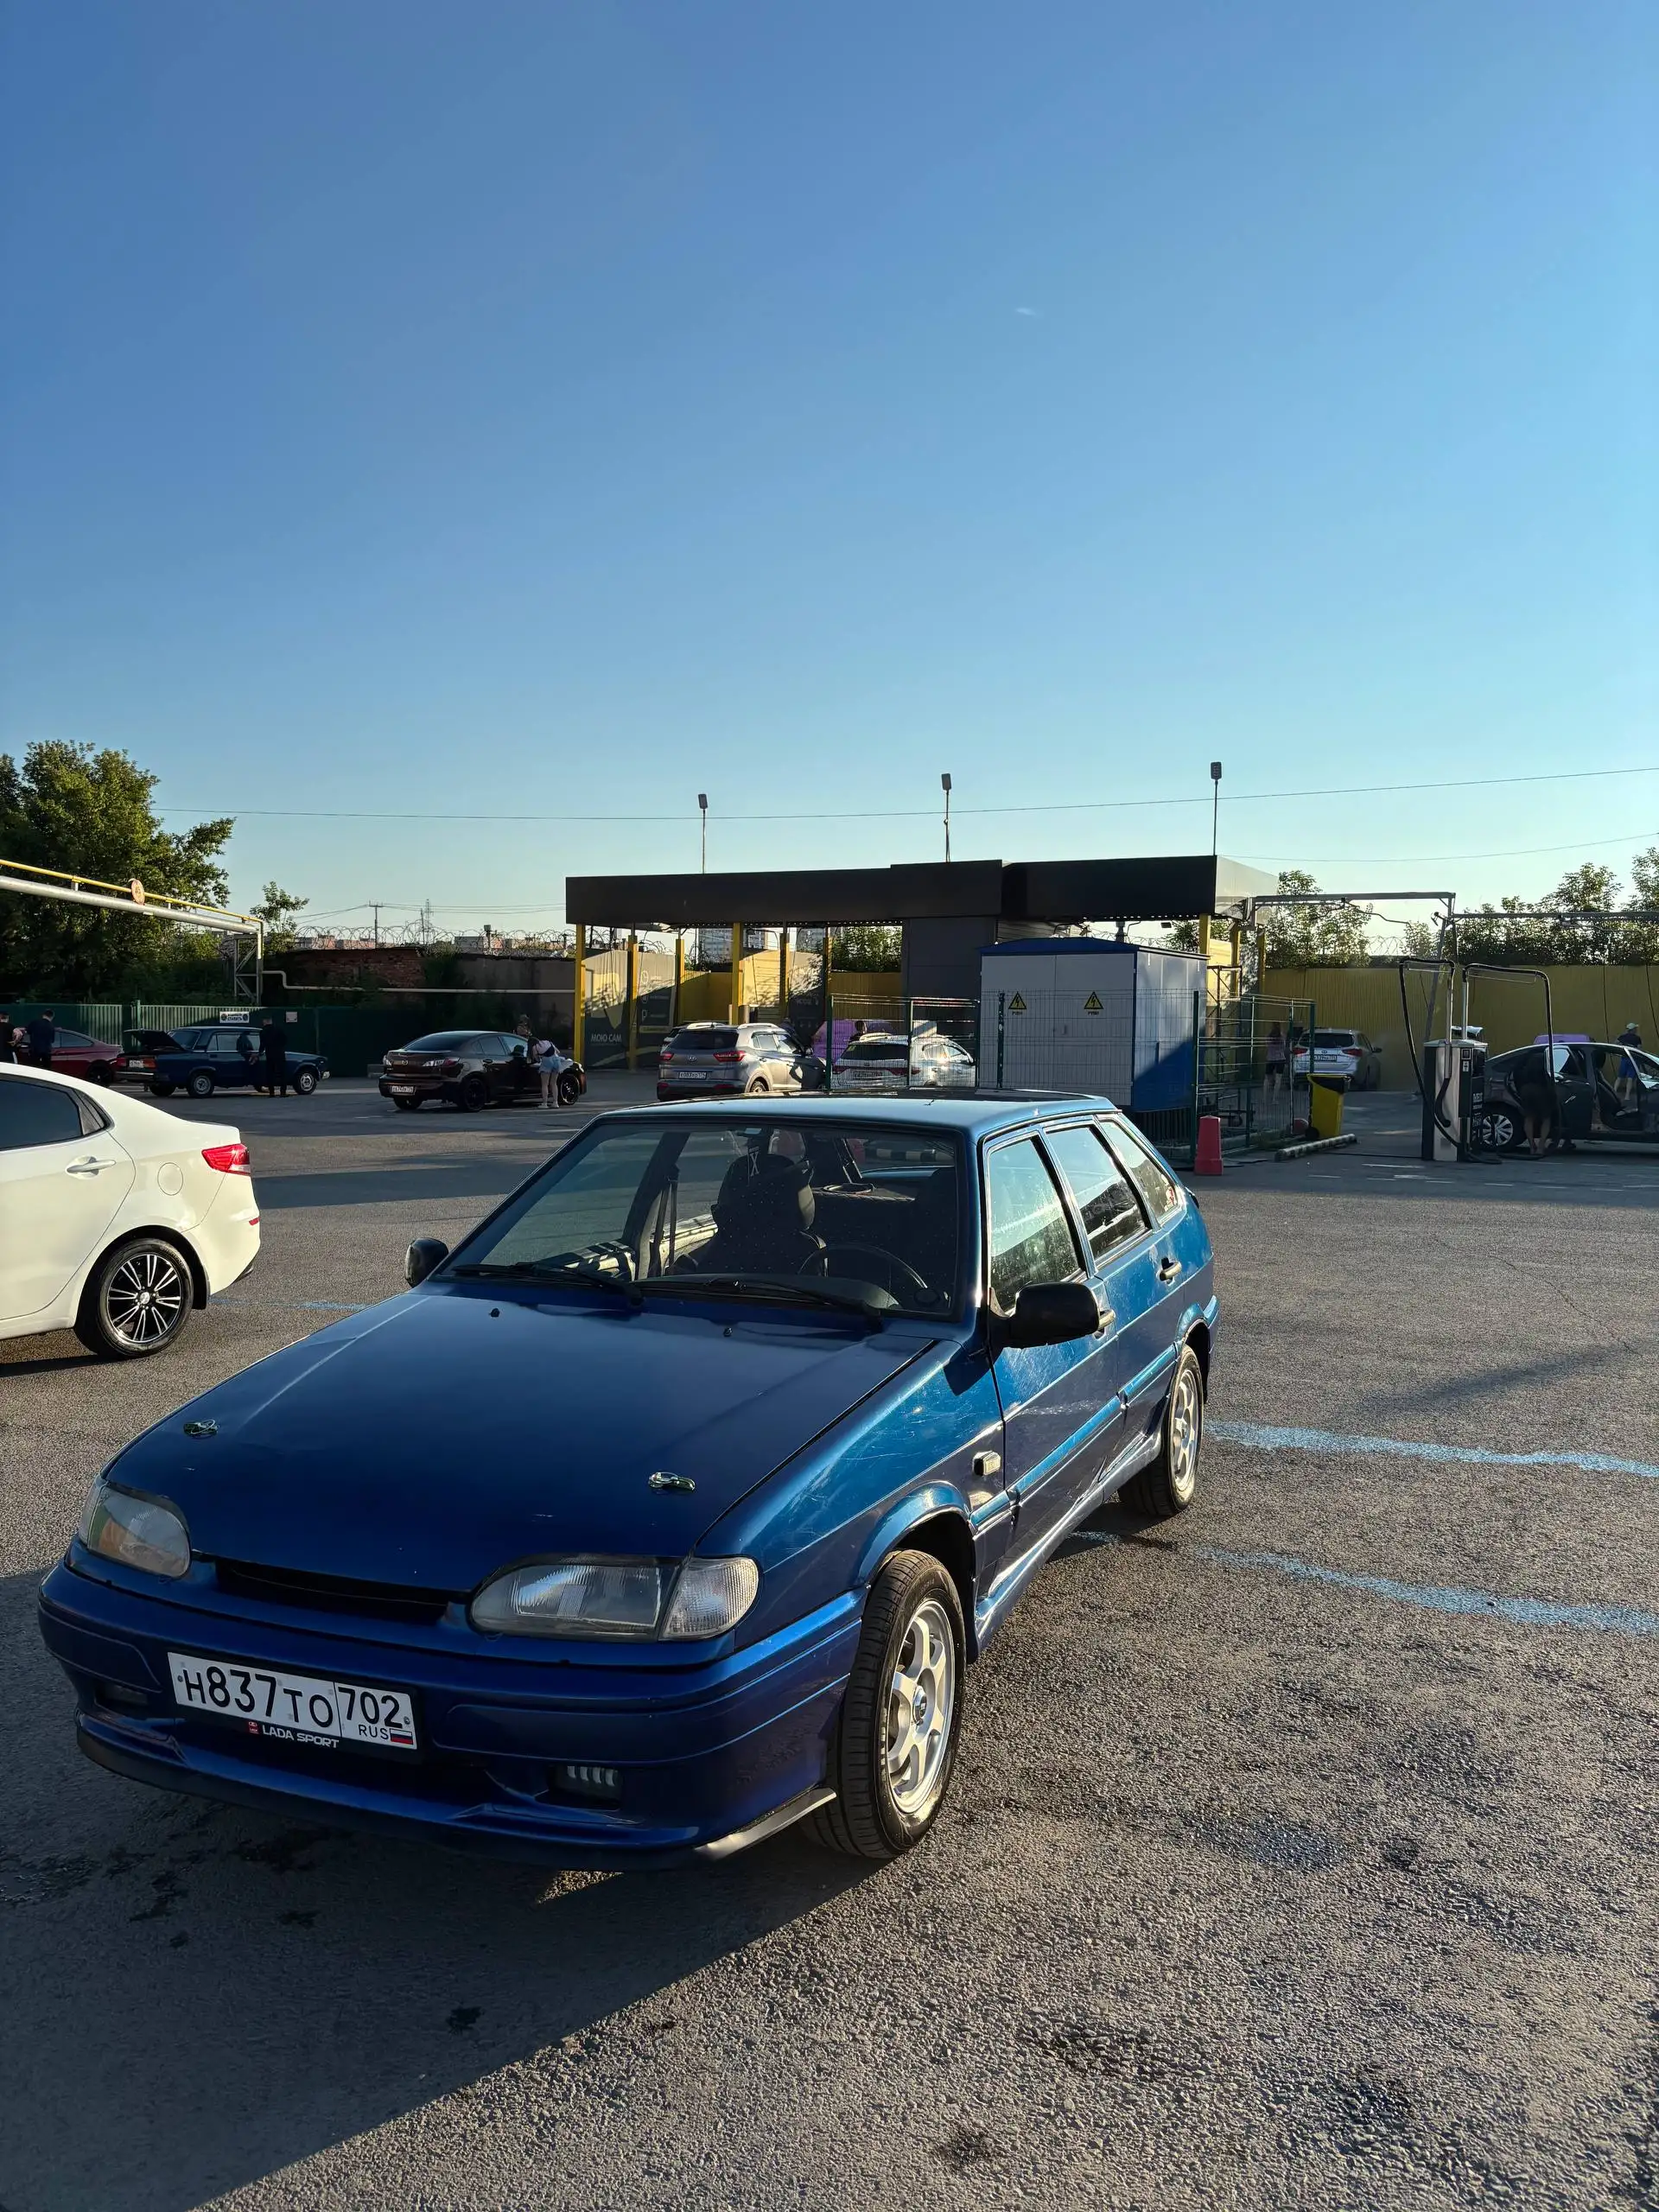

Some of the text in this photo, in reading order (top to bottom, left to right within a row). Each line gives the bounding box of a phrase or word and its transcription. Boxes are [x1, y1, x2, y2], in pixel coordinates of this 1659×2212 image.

[608, 1034, 622, 1043] САМ
[338, 1687, 403, 1728] 702
[262, 1725, 340, 1748] LADA SPORT
[359, 1724, 389, 1740] RUS
